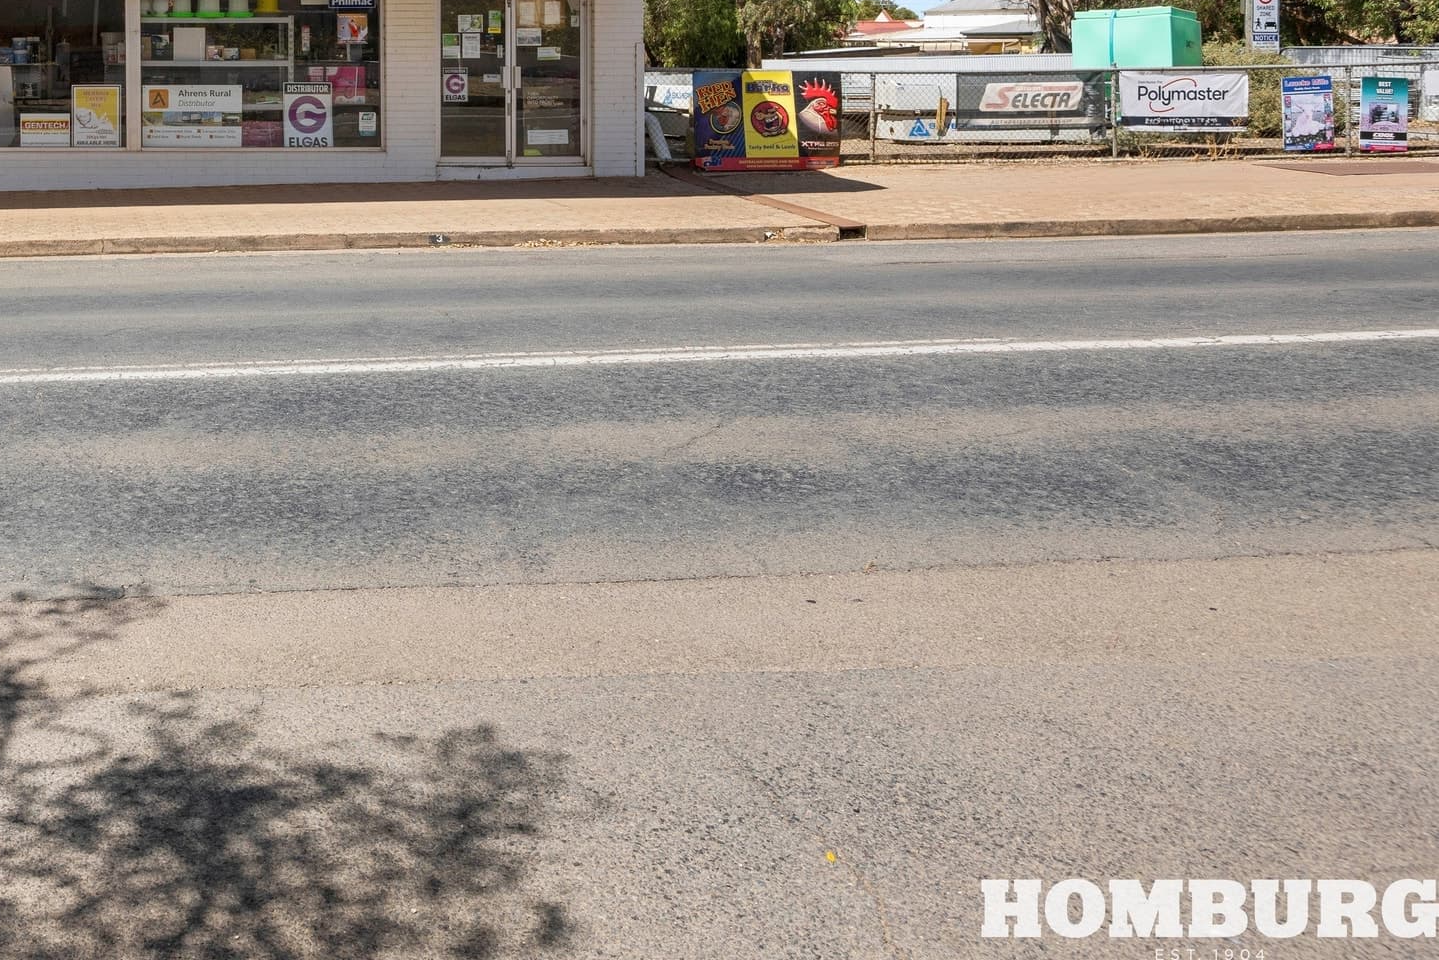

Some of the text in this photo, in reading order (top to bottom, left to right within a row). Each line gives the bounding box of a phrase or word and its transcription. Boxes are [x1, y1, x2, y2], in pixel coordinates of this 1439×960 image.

[178, 89, 232, 97] Ahrens Rural
[286, 84, 329, 93] DISTRIBUTOR
[985, 86, 1074, 110] SELECTA
[1137, 85, 1229, 106] Polymaster
[178, 99, 216, 107] Distributor
[288, 137, 328, 147] ELGAS
